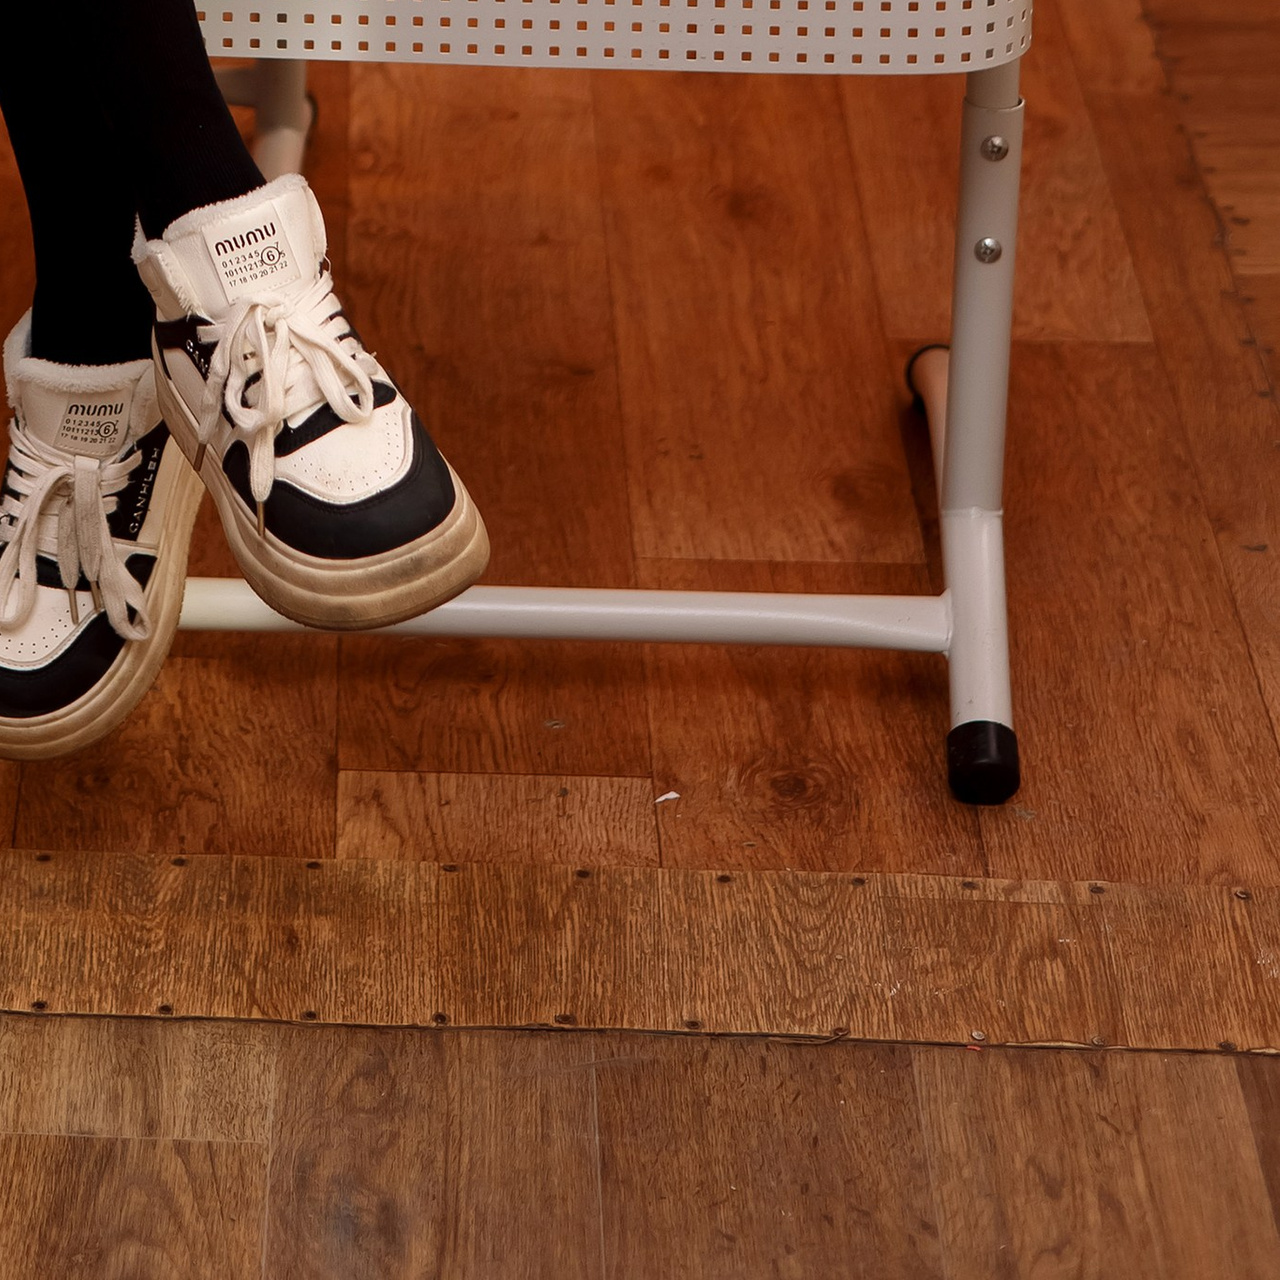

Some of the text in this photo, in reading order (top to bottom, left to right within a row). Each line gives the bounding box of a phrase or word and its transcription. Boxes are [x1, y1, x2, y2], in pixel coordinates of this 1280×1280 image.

[266, 250, 276, 262] 6
[249, 272, 259, 281] 19
[259, 269, 269, 278] 20
[269, 265, 278, 274] 21
[103, 424, 111, 435] 6
